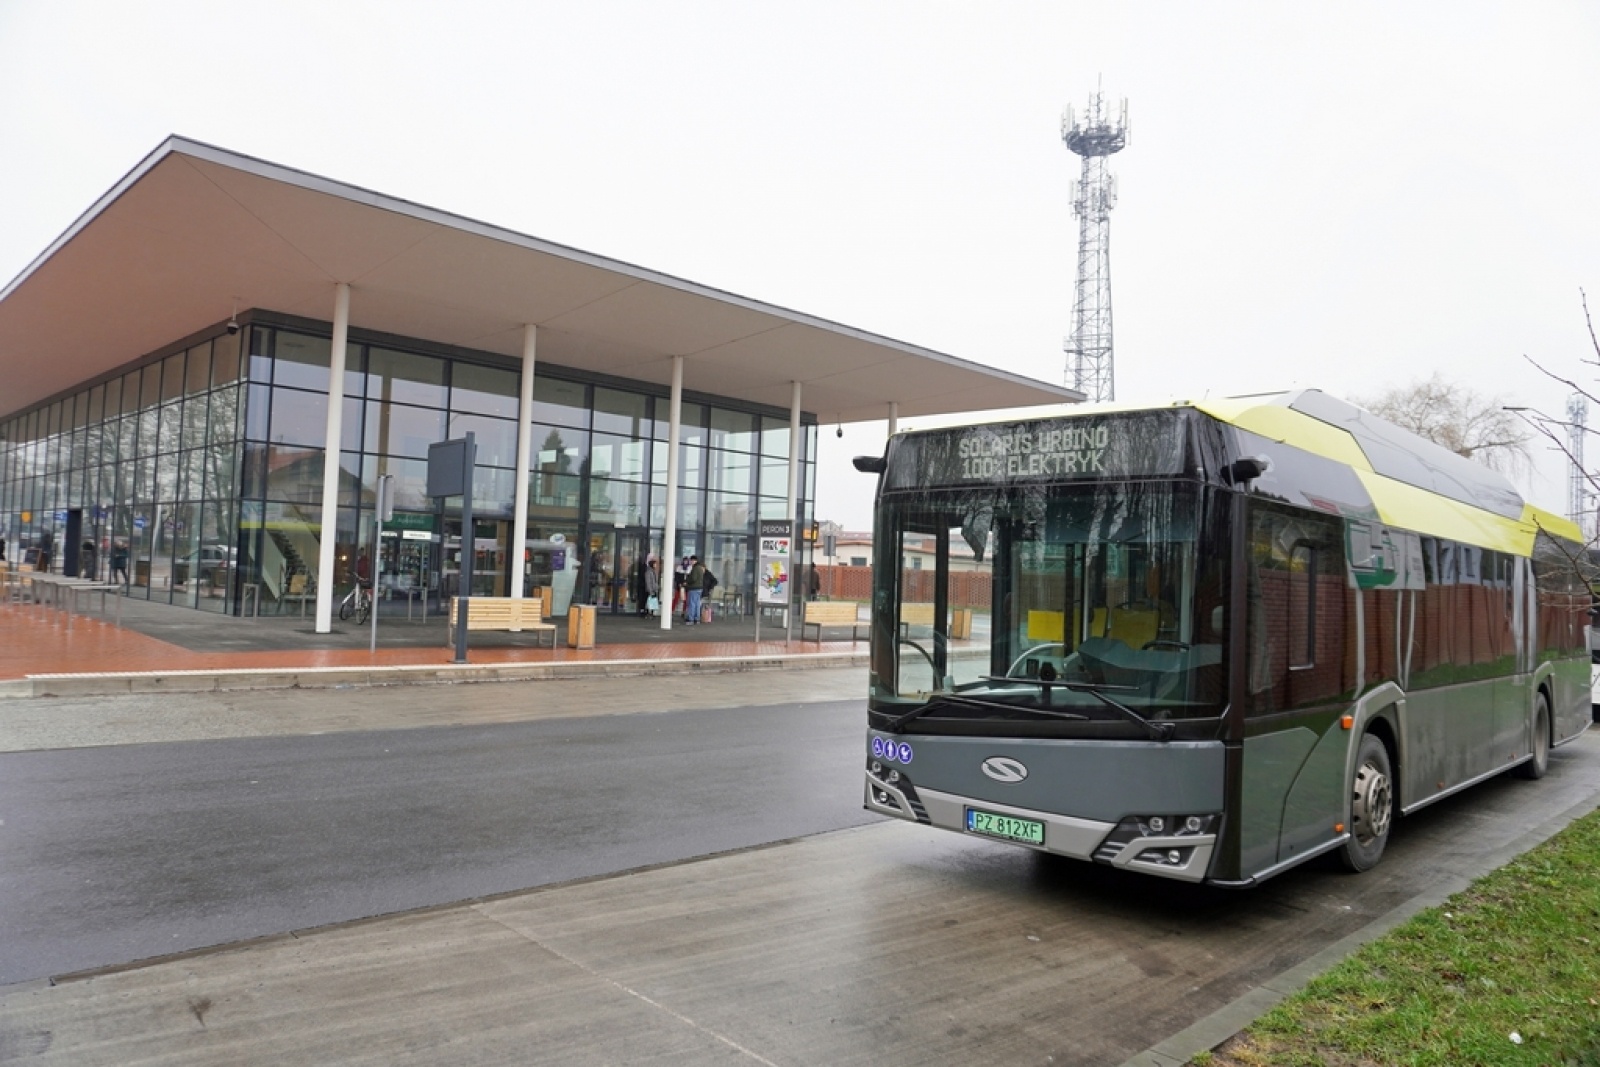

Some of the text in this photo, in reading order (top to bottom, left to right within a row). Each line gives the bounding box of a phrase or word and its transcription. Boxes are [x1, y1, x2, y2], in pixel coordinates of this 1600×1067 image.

[958, 425, 1109, 458] SOLARIS URBINO
[1007, 449, 1104, 476] ELEKTRYK
[762, 525, 785, 534] PERON
[975, 813, 993, 831] PZ
[997, 818, 1039, 838] 812XF
